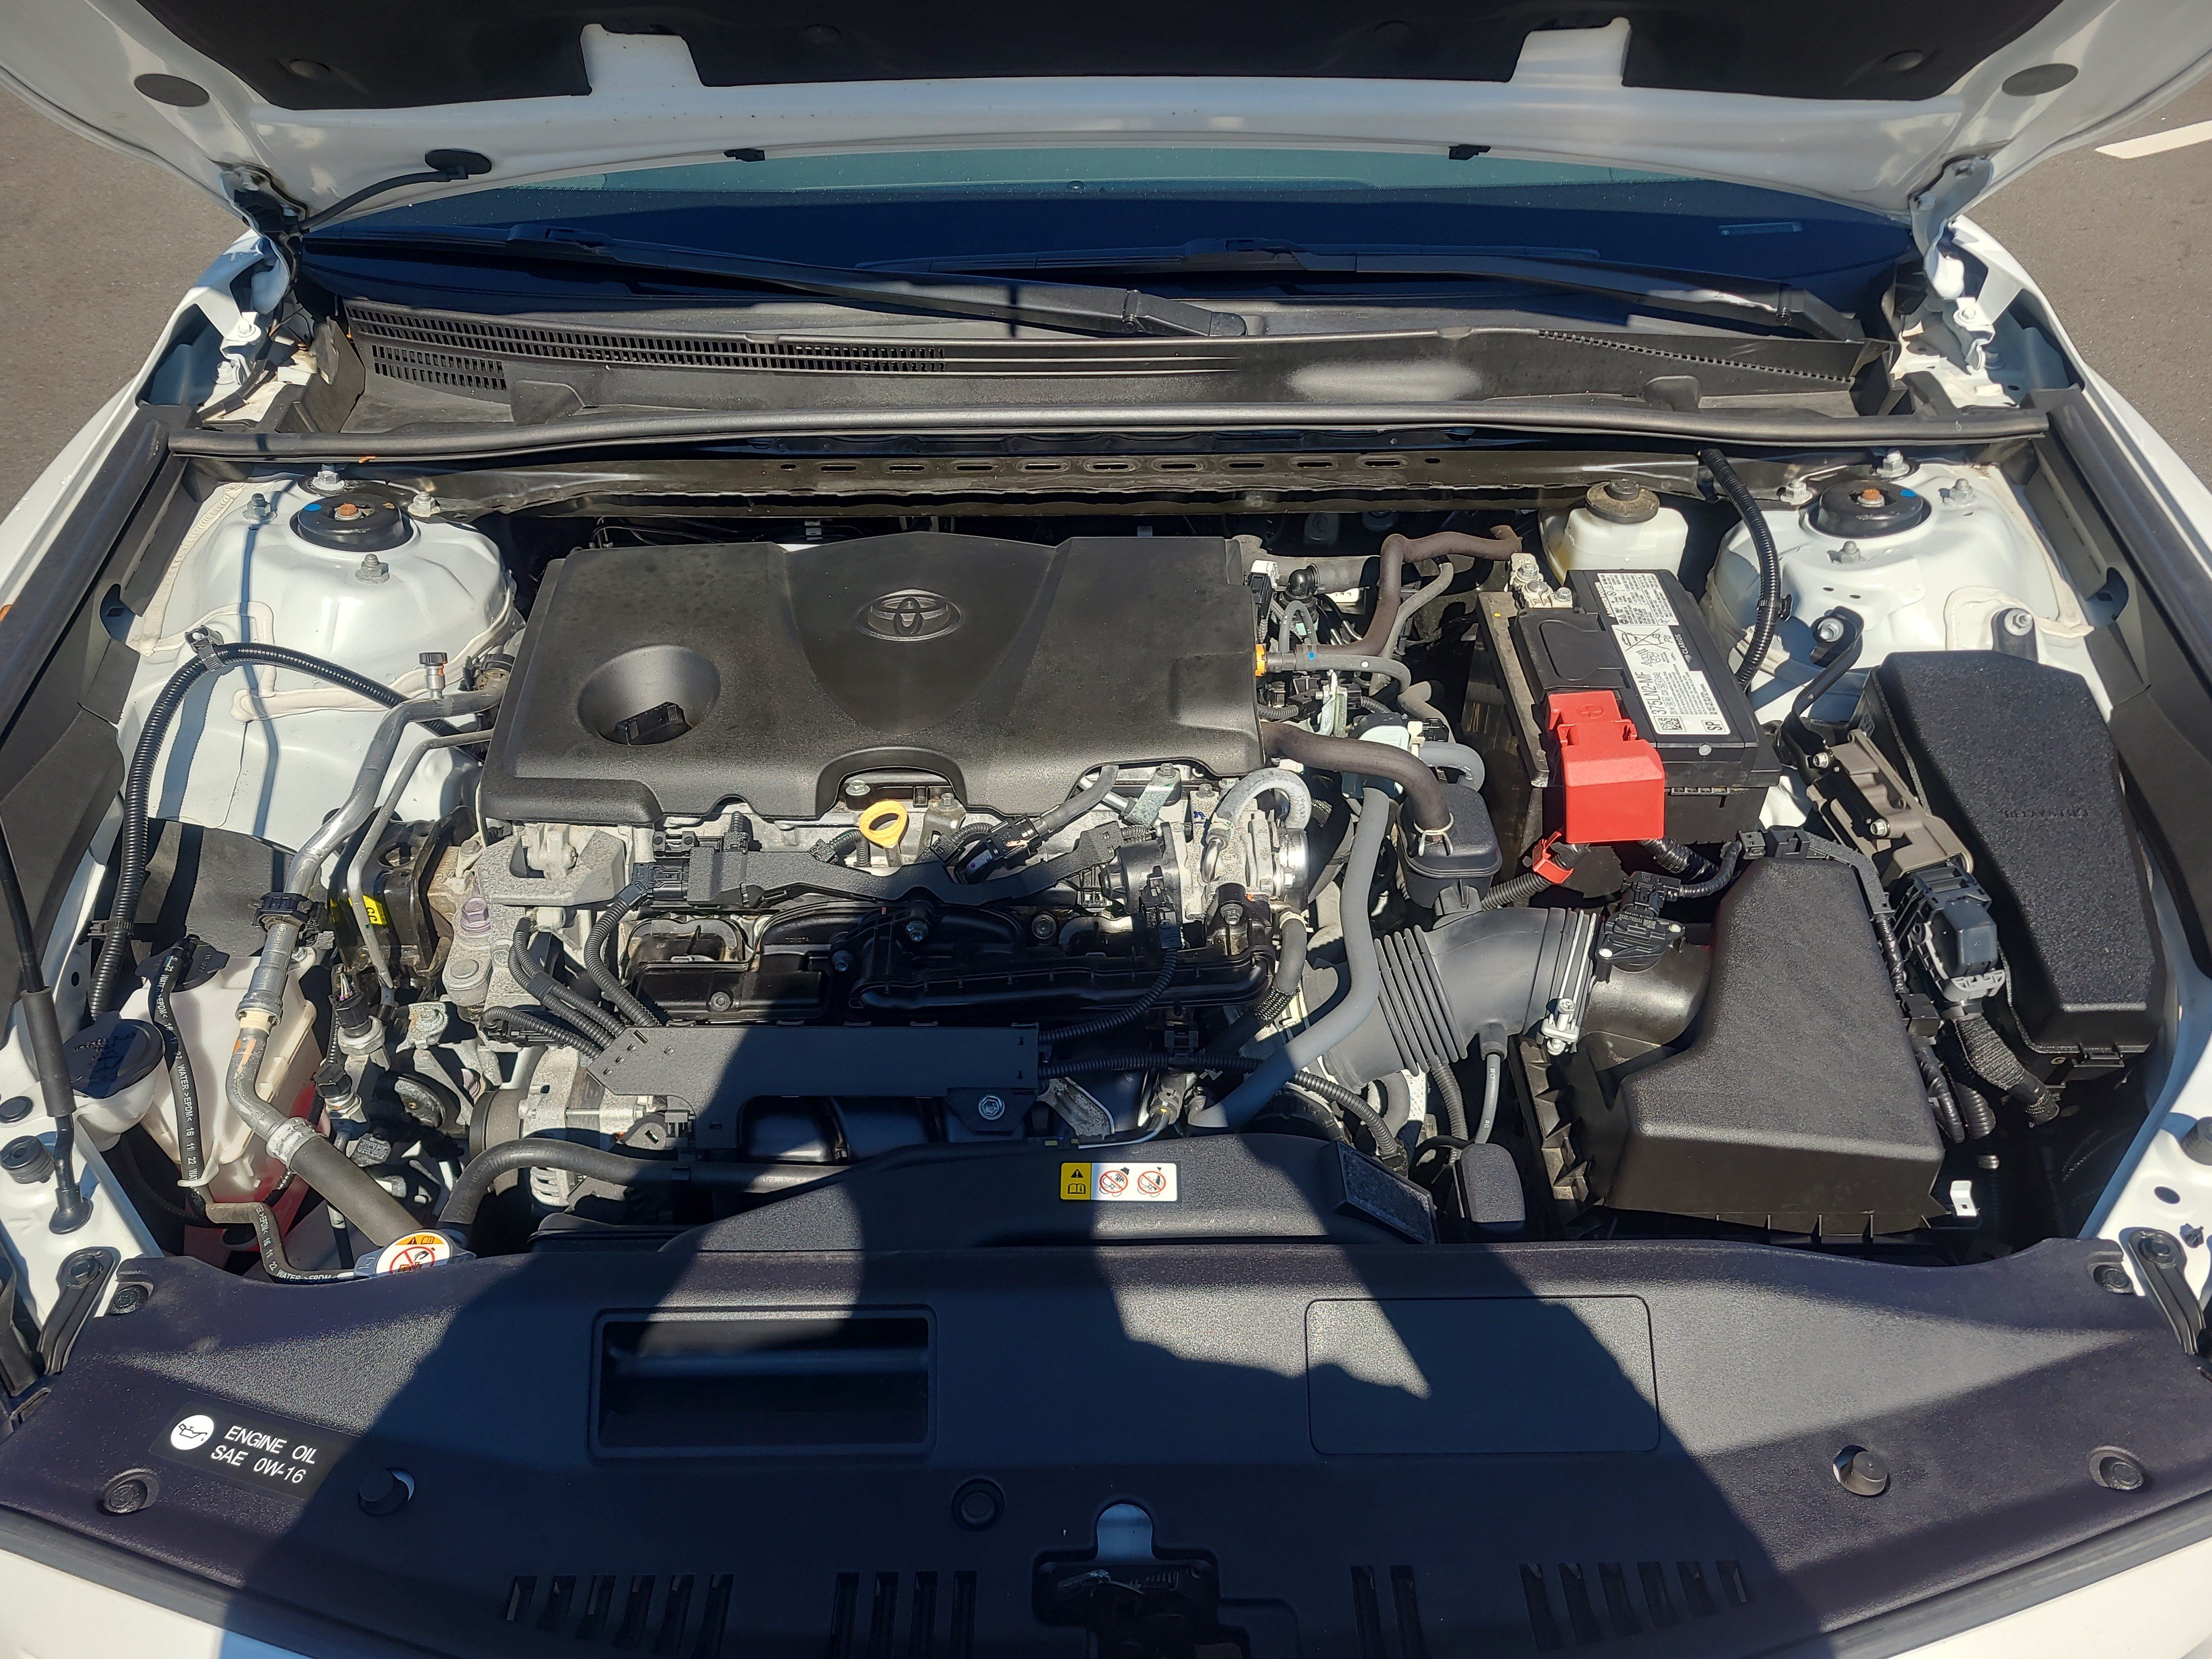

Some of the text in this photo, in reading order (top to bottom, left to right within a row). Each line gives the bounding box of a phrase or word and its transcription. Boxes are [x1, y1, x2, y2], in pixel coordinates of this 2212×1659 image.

[1674, 634, 1689, 654] CLARIOS
[1635, 672, 1667, 714] 375LN2-MF
[1705, 721, 1723, 730] SP
[156, 973, 170, 993] WATER
[177, 1064, 189, 1091] WATER
[185, 1127, 194, 1137] 16
[187, 1143, 195, 1151] 11
[266, 1249, 274, 1259] 11
[269, 1261, 278, 1272] 22
[276, 1269, 301, 1282] WATER
[224, 1425, 317, 1464] ENGINE OIL
[211, 1445, 306, 1484] SAE 0W-16
